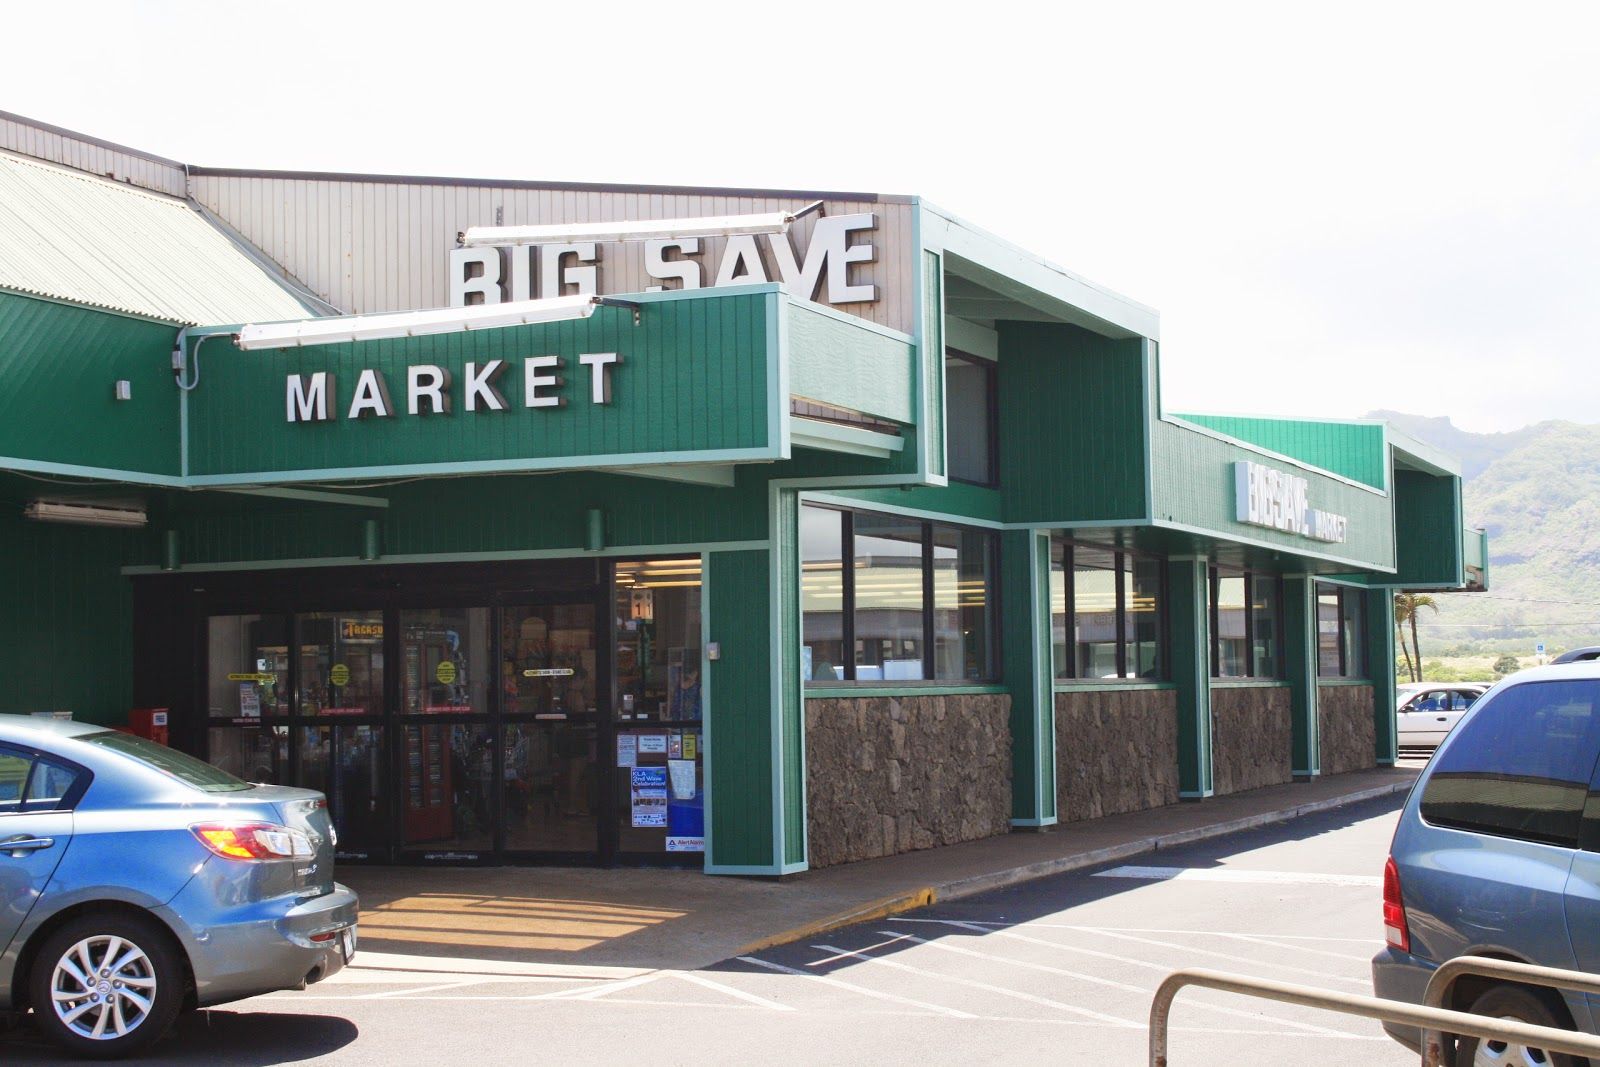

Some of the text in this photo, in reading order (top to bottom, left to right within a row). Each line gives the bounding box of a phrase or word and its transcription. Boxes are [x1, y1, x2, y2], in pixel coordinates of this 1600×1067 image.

[449, 213, 880, 308] BIG SAVE
[286, 351, 621, 423] MARKET
[1312, 509, 1347, 543] MARKET
